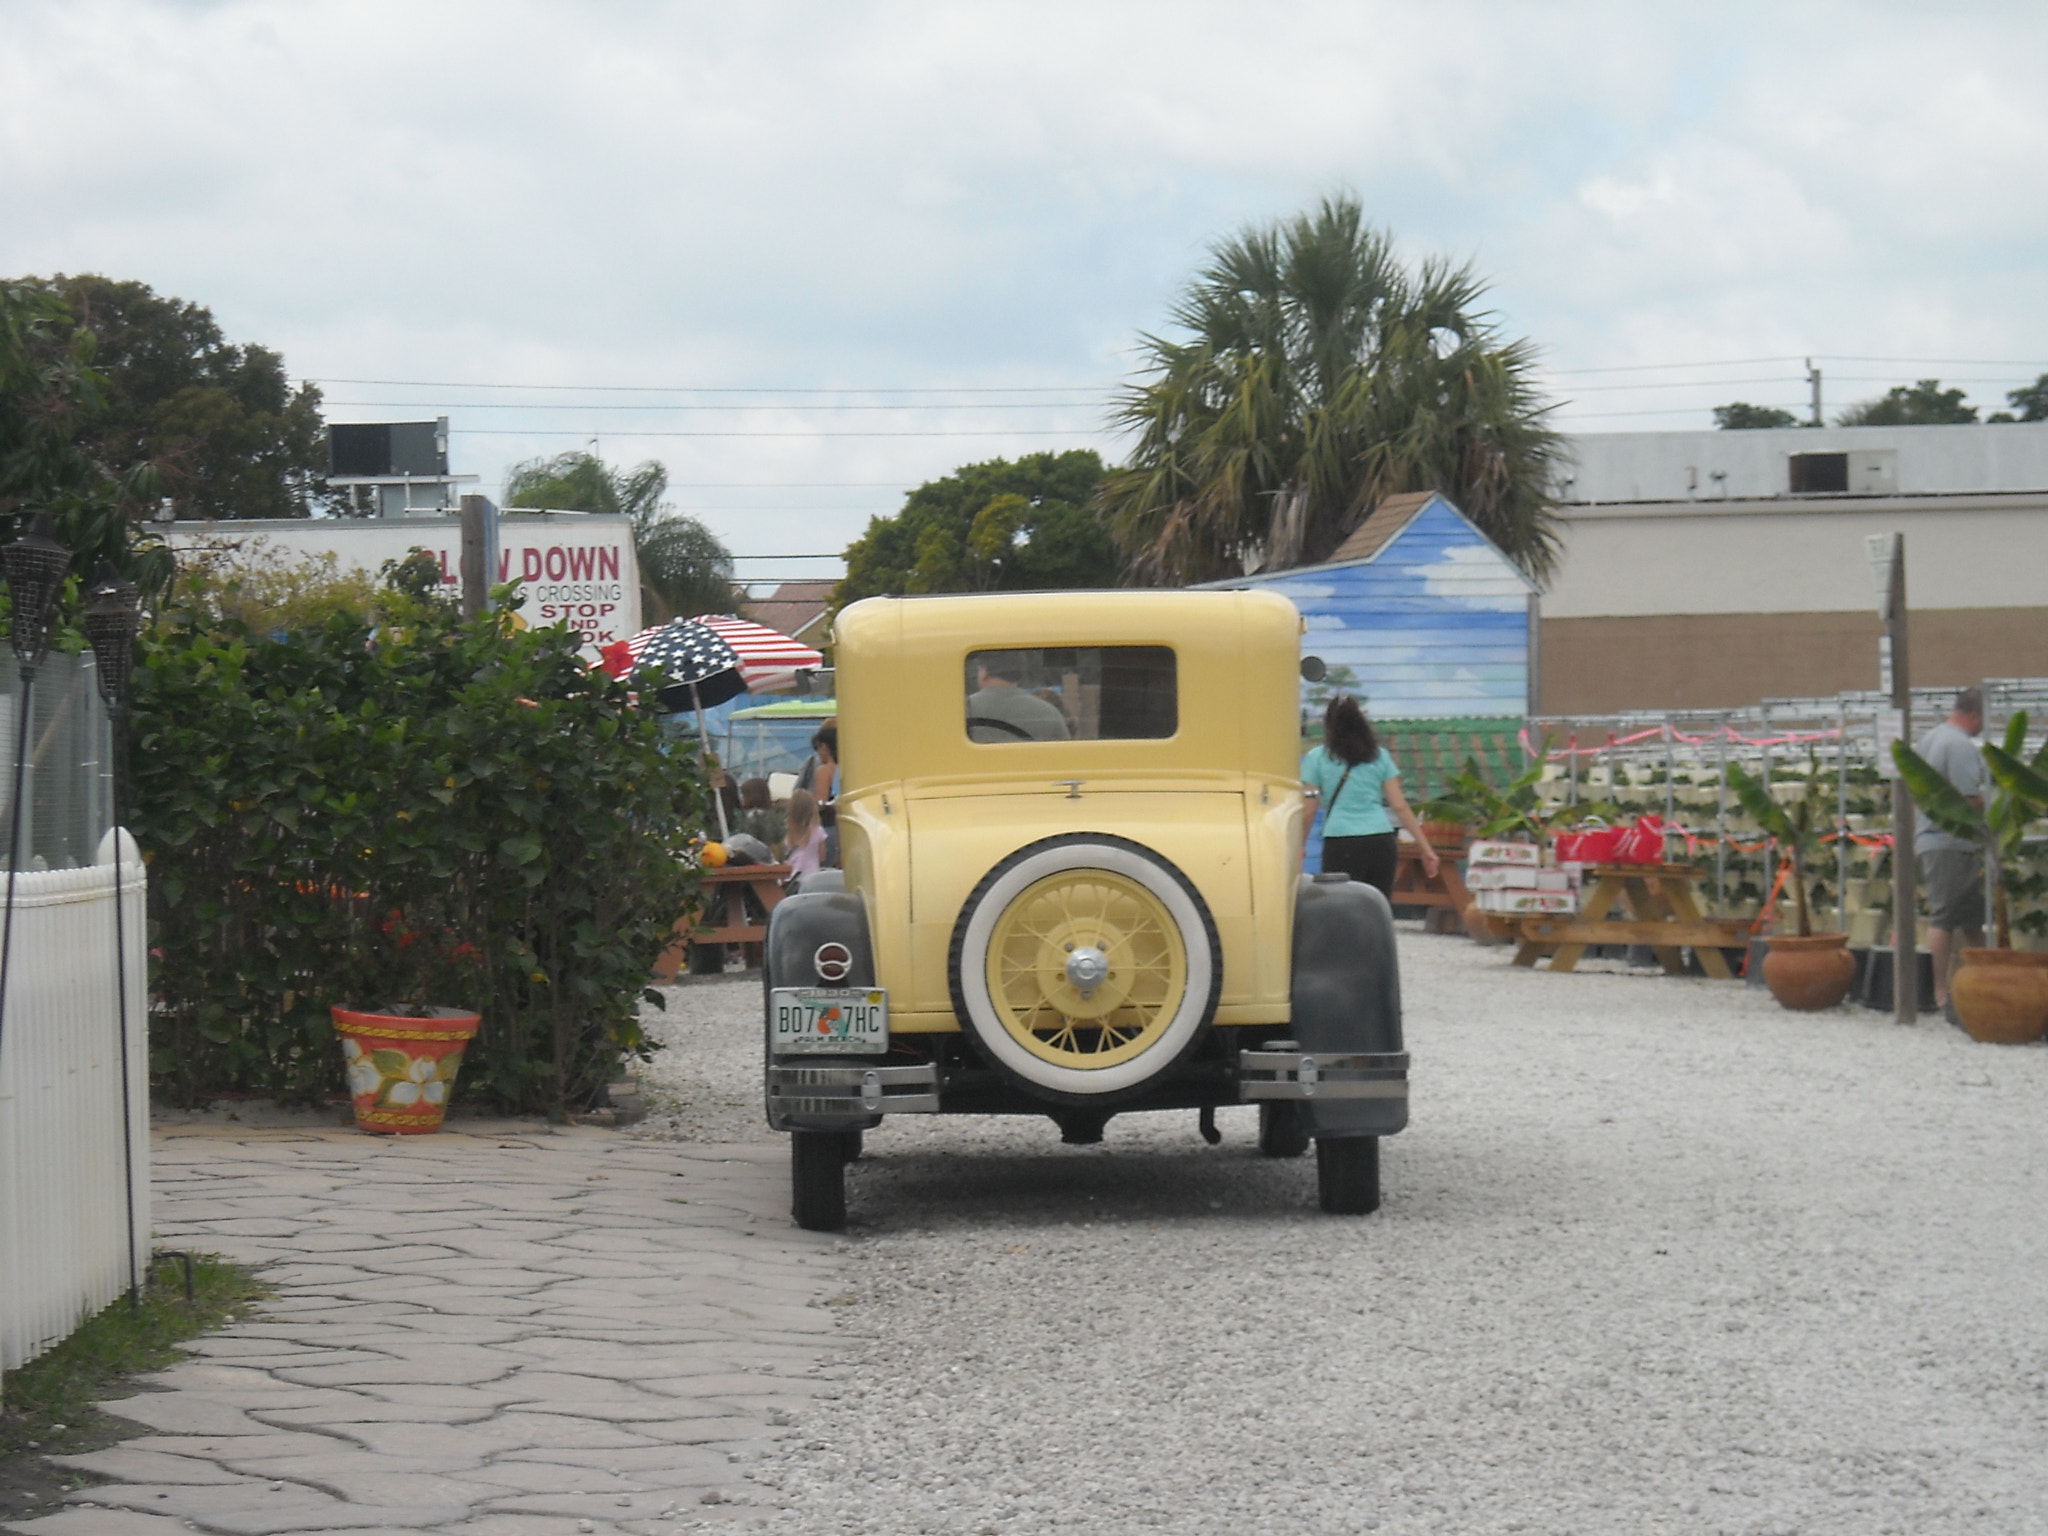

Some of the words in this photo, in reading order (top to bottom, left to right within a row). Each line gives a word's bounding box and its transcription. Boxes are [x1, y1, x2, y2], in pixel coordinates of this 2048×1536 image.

[522, 546, 619, 582] DOWN
[537, 584, 621, 602] CROSSING
[540, 603, 615, 618] STOP
[564, 619, 599, 629] ND
[580, 630, 614, 643] OK
